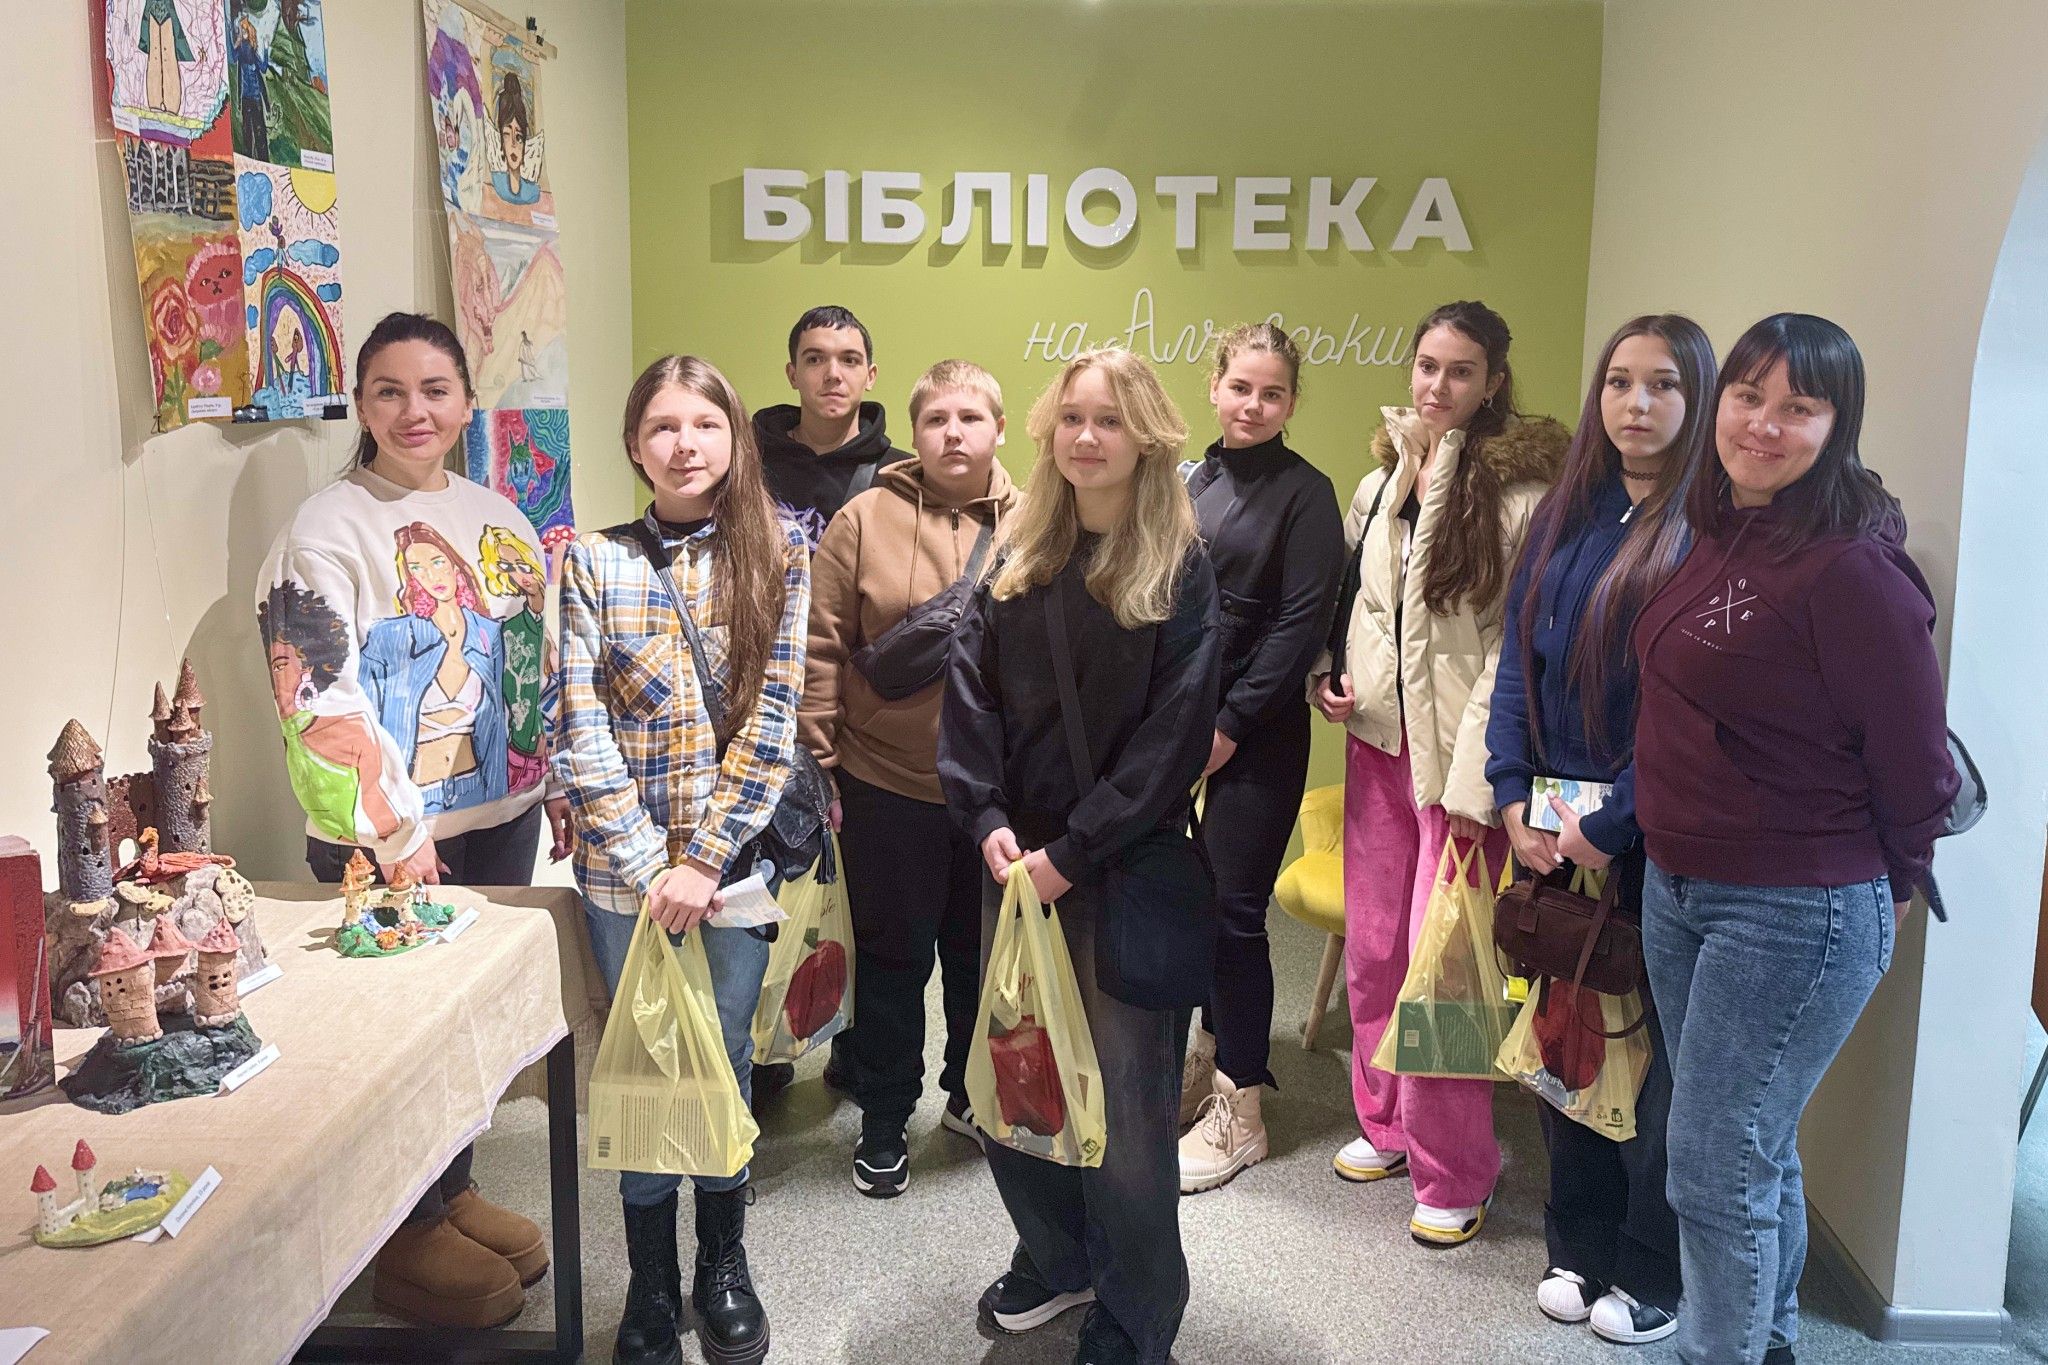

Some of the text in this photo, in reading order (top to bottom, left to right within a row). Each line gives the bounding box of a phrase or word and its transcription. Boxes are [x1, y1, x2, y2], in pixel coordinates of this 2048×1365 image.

[743, 167, 1474, 251] БІБЛІОТЕКА
[1704, 610, 1753, 628] P E
